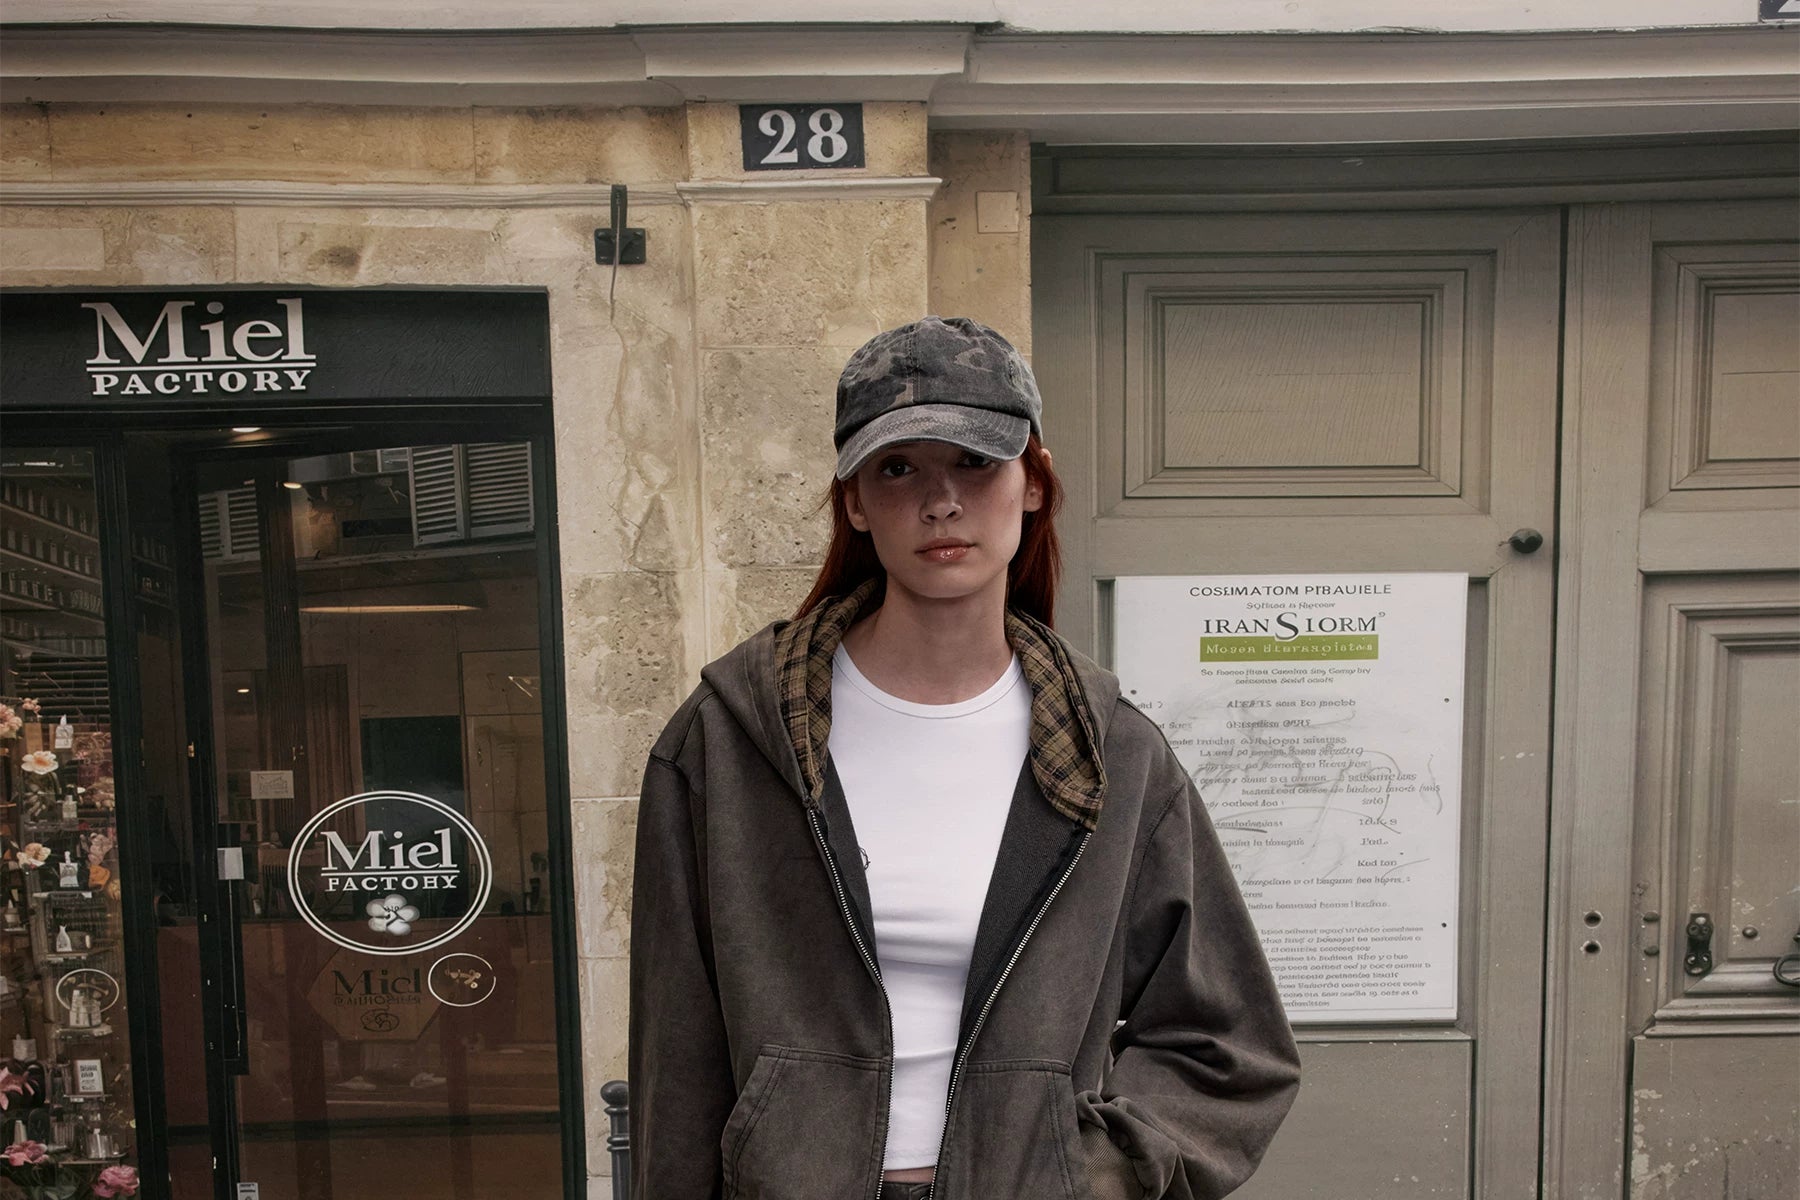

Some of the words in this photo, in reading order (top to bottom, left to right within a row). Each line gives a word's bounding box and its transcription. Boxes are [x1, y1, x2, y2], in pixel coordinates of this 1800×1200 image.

[758, 108, 848, 164] 28
[81, 298, 316, 364] Miel
[320, 828, 458, 870] Miel
